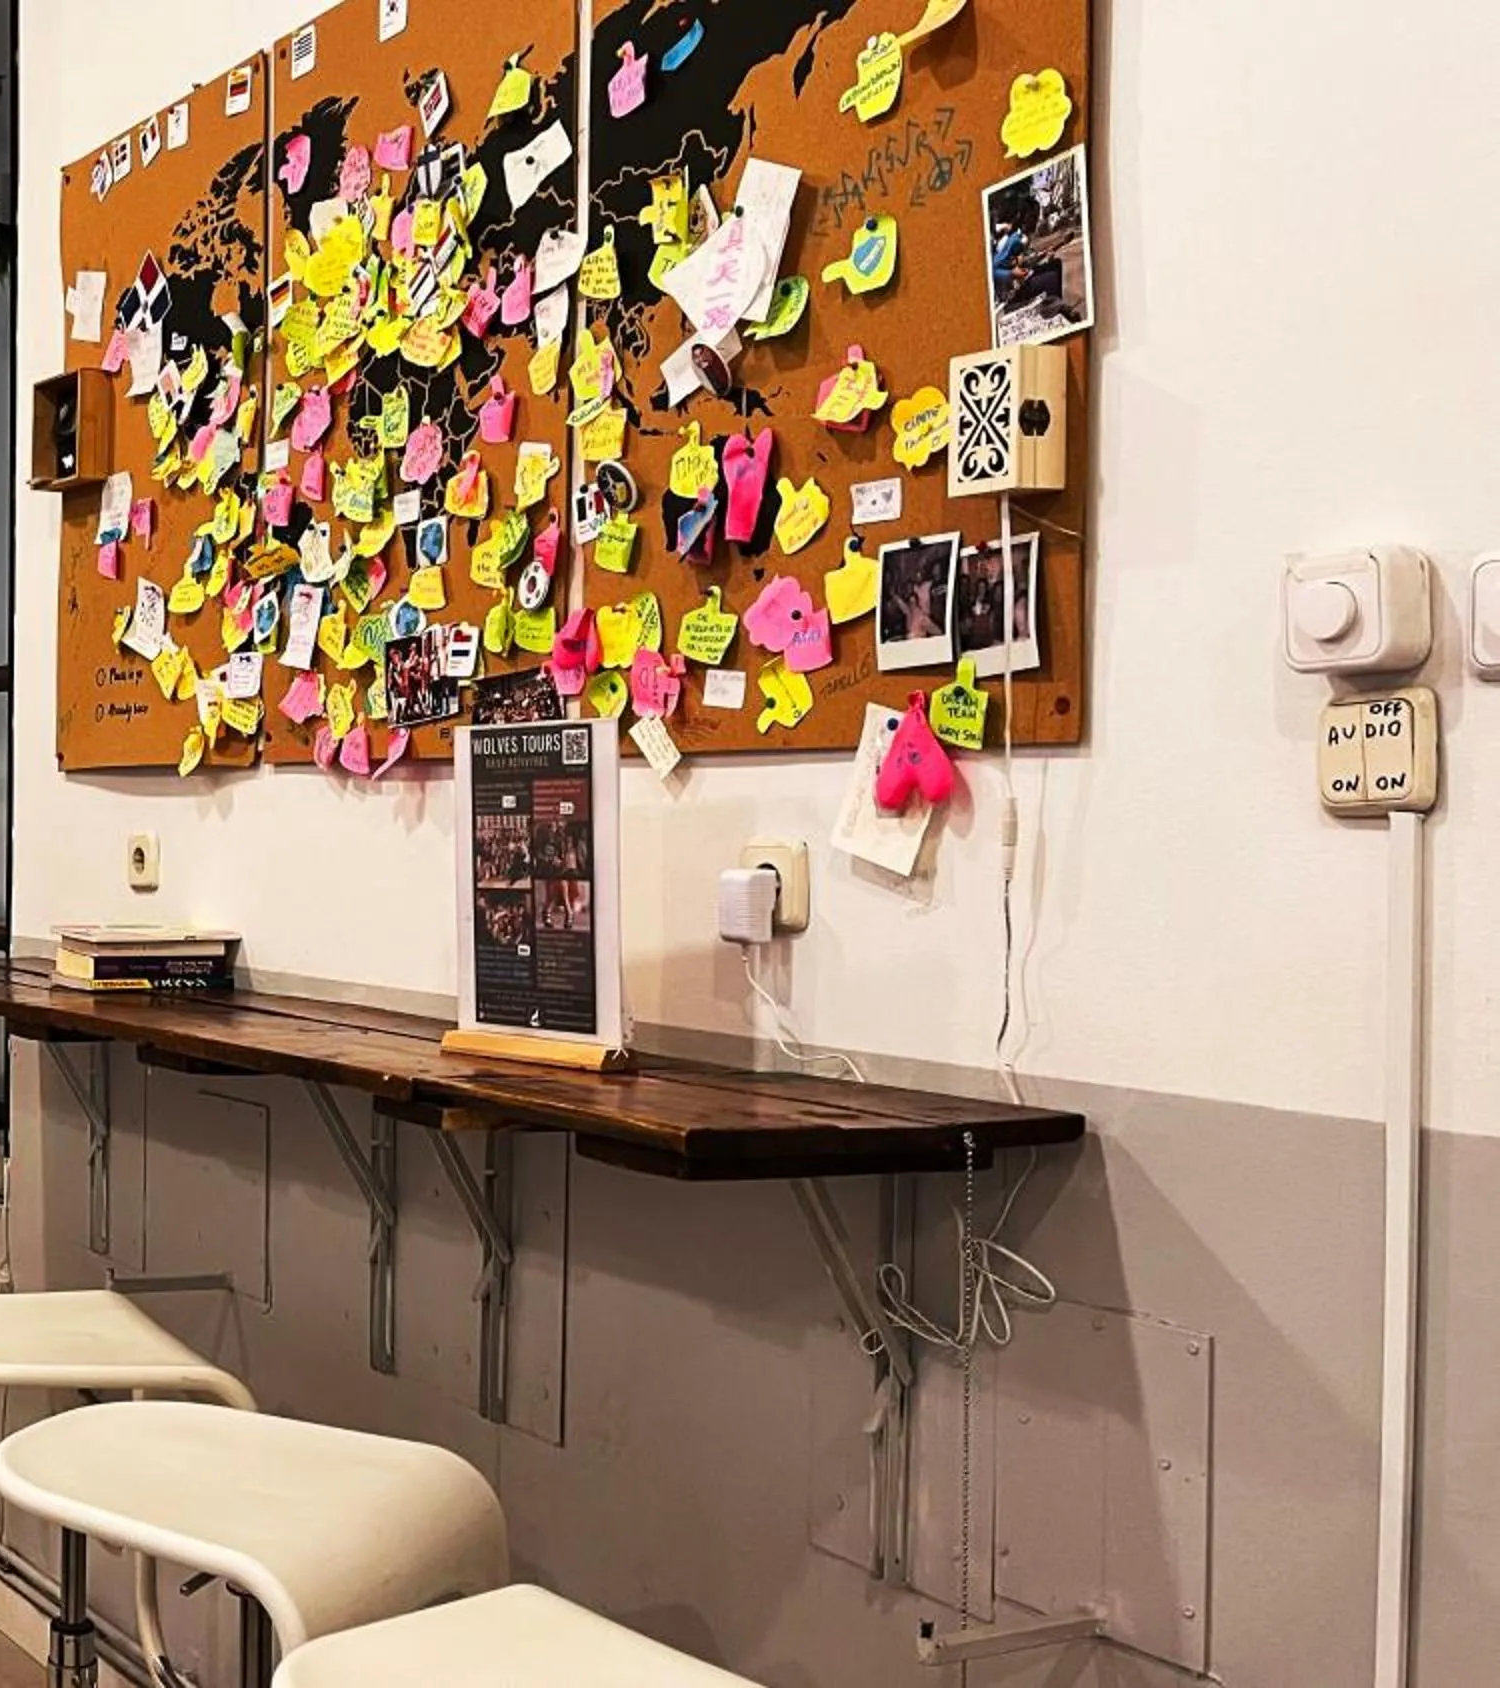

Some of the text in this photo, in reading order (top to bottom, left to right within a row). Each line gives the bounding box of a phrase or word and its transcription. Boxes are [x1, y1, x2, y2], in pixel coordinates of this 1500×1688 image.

[1369, 701, 1402, 717] OFF
[1328, 719, 1401, 746] AUDIO
[471, 733, 561, 755] WOLVES TOURS
[1332, 772, 1406, 792] ON ON
